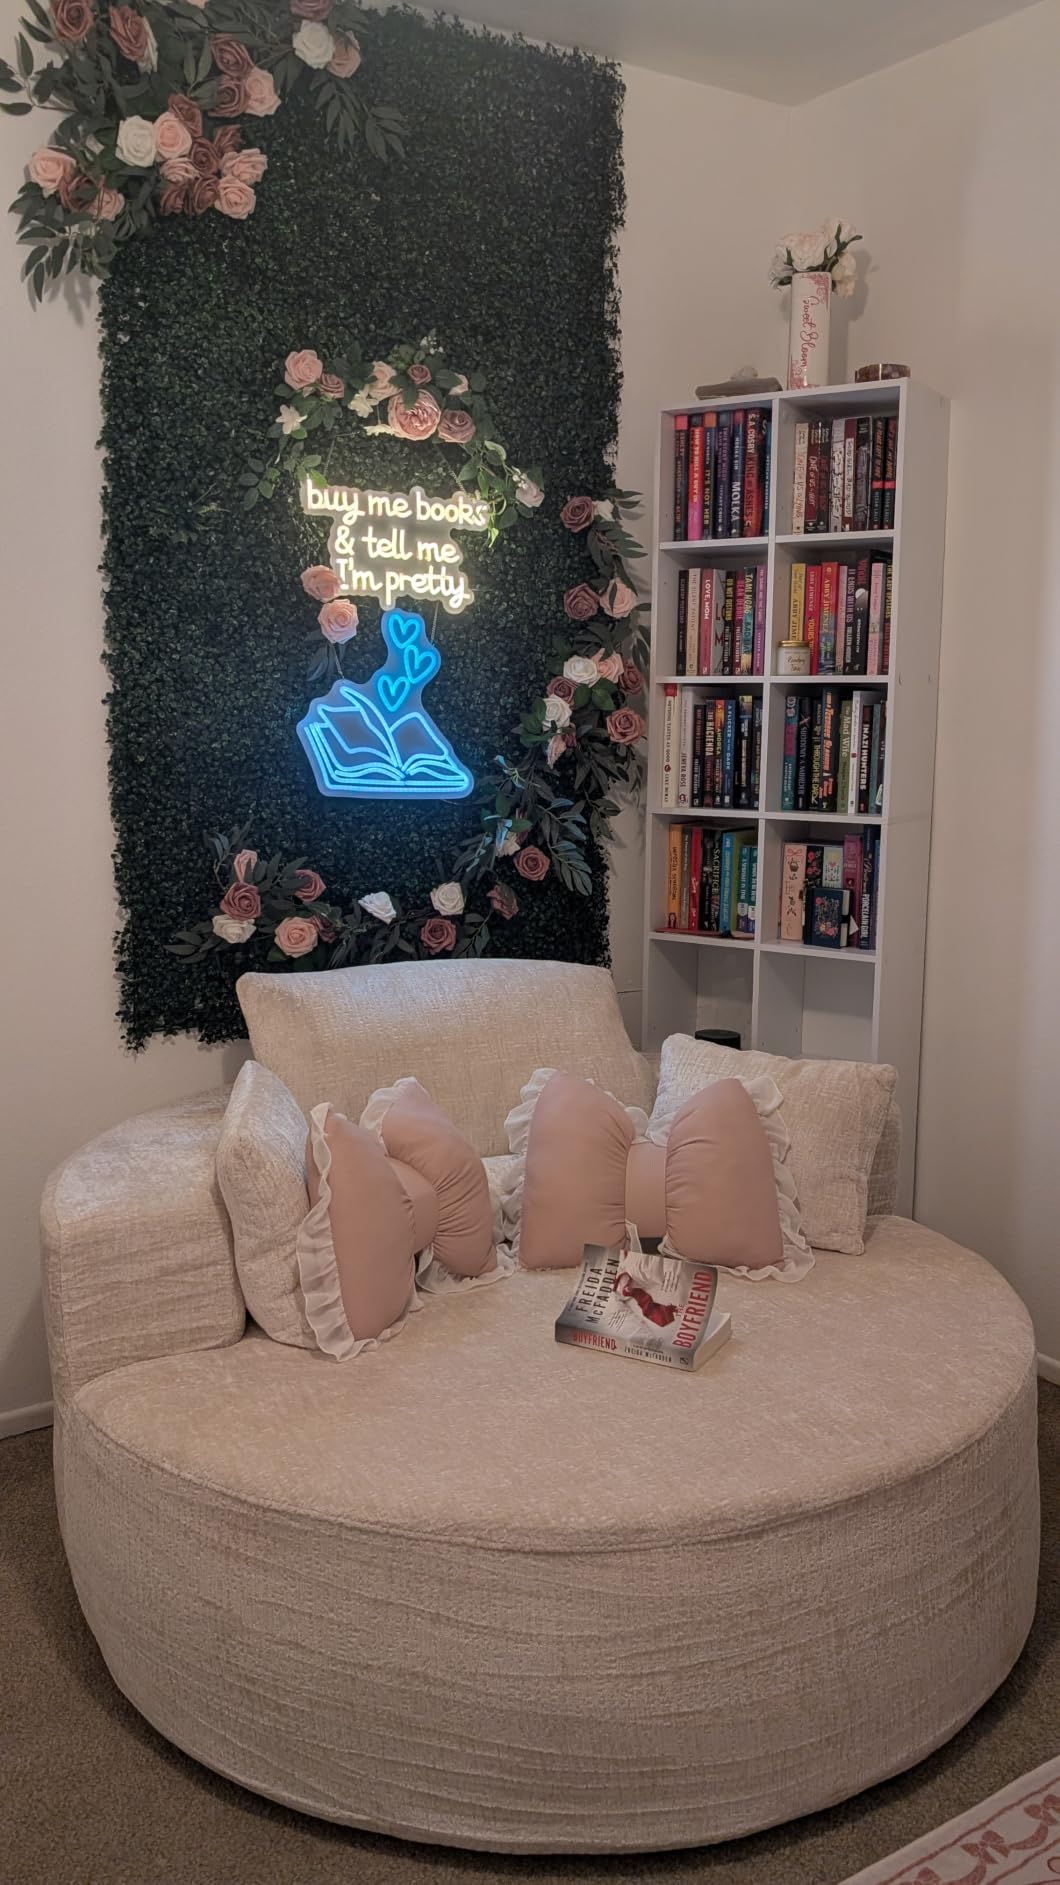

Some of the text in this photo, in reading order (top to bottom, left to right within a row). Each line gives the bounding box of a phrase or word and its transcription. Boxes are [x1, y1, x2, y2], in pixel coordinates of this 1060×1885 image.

[746, 429, 756, 454] COSBY
[808, 455, 818, 472] ONE
[306, 478, 488, 526] buy me books
[731, 481, 741, 522] MOLKA
[745, 489, 754, 518] ASHES
[335, 525, 459, 563] & tell me
[336, 558, 470, 608] I'm pretty
[703, 579, 711, 601] LOVE,
[744, 573, 754, 614] TAMI HOAG
[823, 578, 831, 598] ABBY
[847, 577, 856, 594] ENDS
[847, 595, 855, 613] WITH
[743, 621, 752, 637] BAD
[807, 618, 815, 640] YOURS
[846, 613, 854, 623] US
[843, 715, 852, 735] Mad
[705, 721, 714, 756] HACIENDA
[841, 736, 850, 758] Wife
[861, 727, 870, 748] NAZI
[679, 773, 687, 788] ROSE
[812, 773, 820, 783] THE
[860, 749, 868, 790] HUNTERS
[712, 849, 720, 893] SACRIFICE
[861, 894, 870, 925] PORCELAIN
[576, 1268, 603, 1312] FREIDA
[672, 1271, 713, 1349] BOYFRIEND
[676, 1303, 686, 1318] THE
[572, 1330, 617, 1351] BOYFRIEND
